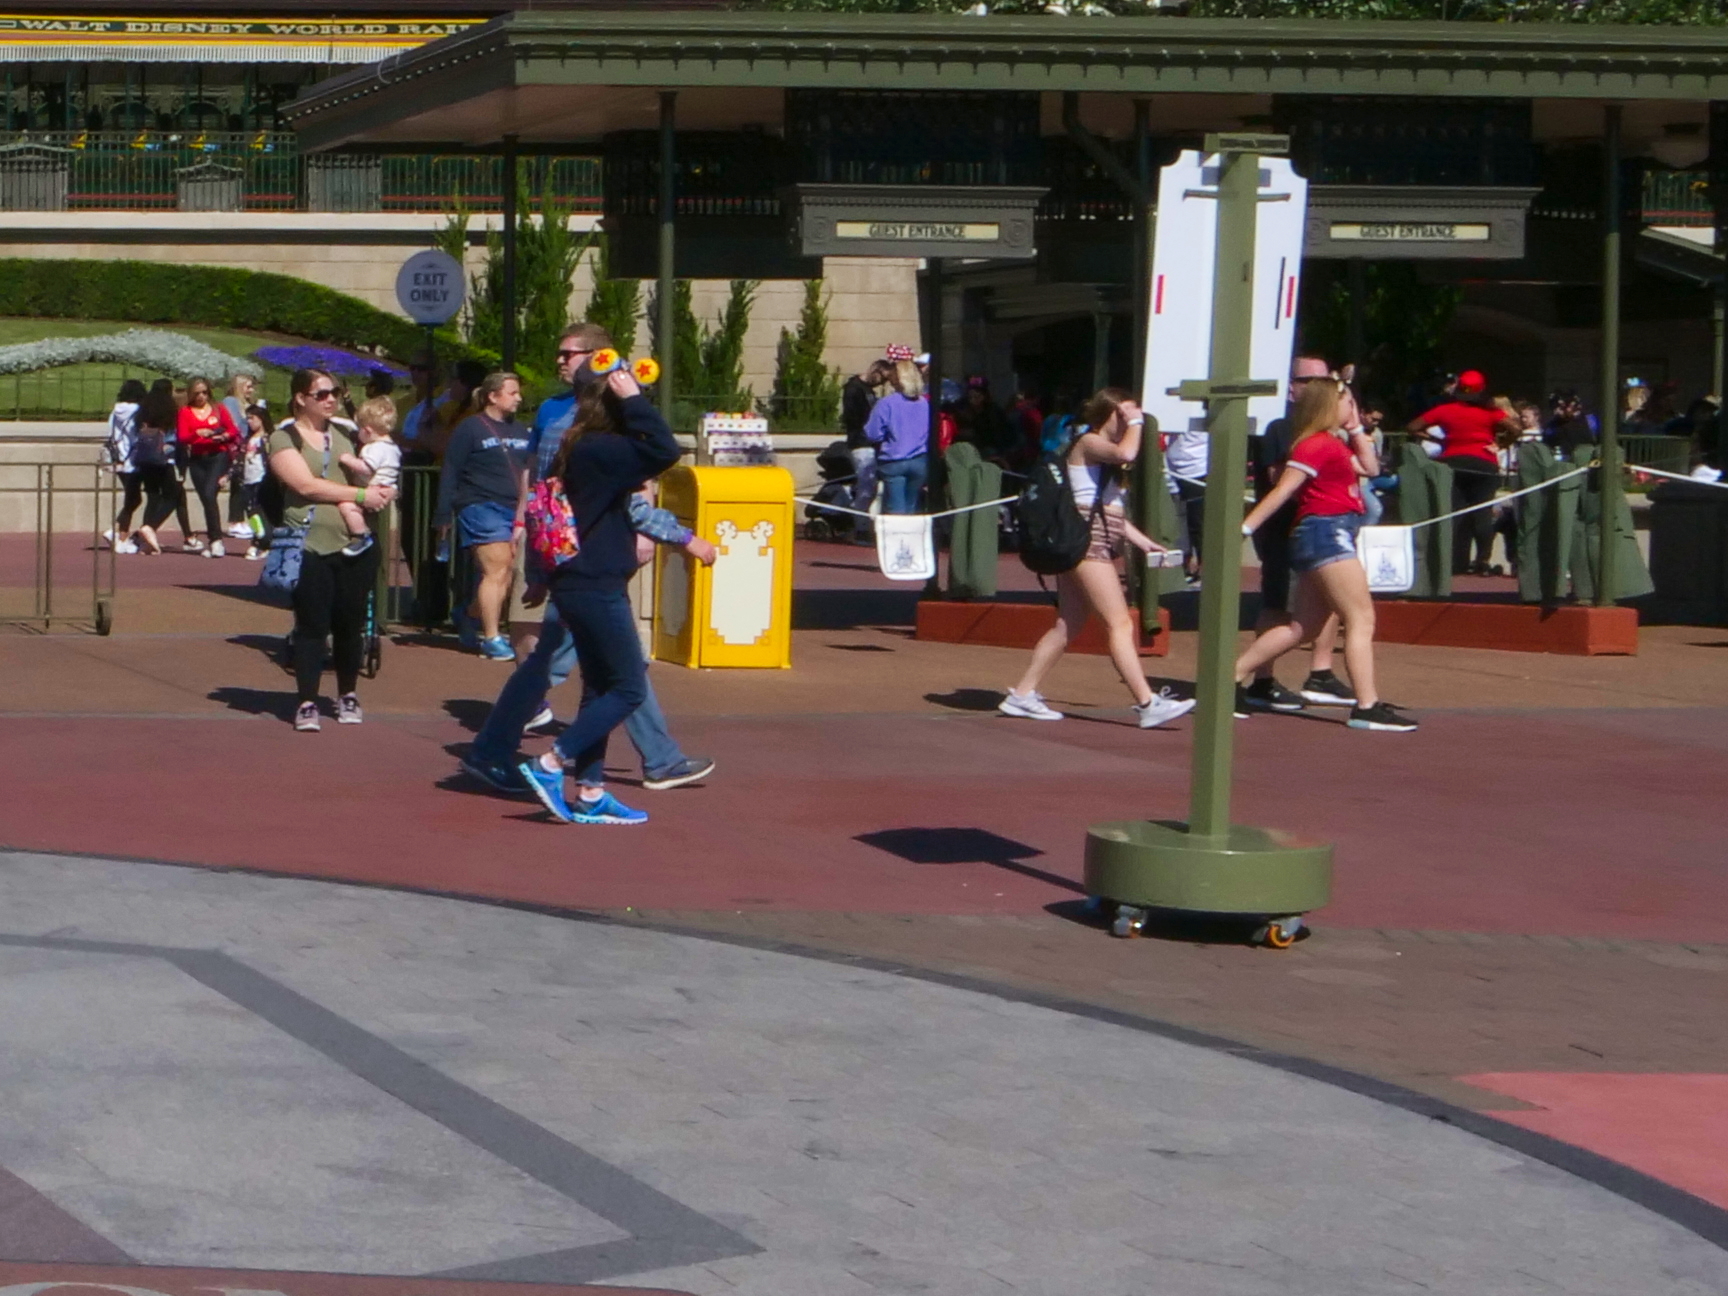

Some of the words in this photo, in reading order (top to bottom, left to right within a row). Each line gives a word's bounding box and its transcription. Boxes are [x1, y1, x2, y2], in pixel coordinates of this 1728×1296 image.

[19, 19, 111, 32] WALT
[125, 21, 252, 34] DISNEY
[266, 23, 388, 35] WORLD
[869, 224, 905, 237] GUEST
[909, 224, 966, 237] ENTRANCE
[1360, 225, 1395, 238] GUEST
[1399, 224, 1456, 238] ENTRANCE
[413, 272, 448, 286] EXIT
[410, 289, 450, 302] ONLY
